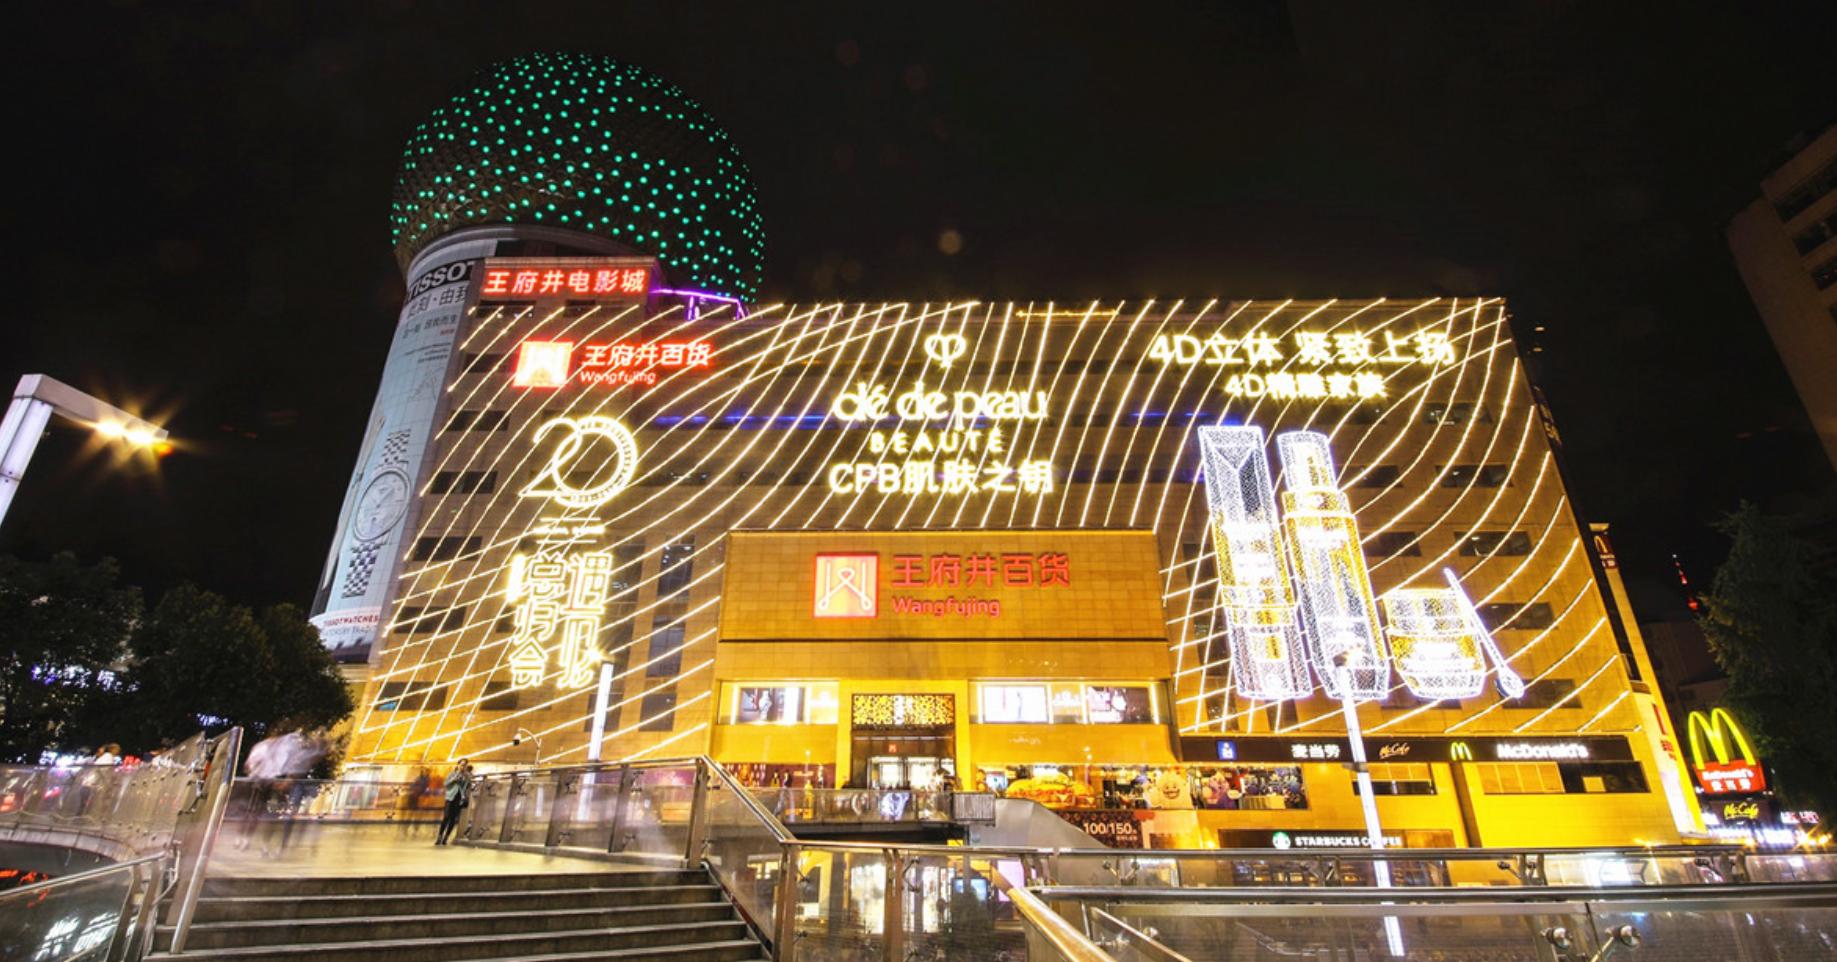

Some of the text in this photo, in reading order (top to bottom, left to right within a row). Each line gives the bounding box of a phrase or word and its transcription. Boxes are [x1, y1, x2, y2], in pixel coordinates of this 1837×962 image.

[484, 269, 647, 294] 王府井电影城
[581, 342, 712, 369] 王府井百货
[1150, 332, 1283, 366] 4D立体
[580, 370, 656, 386] Wangfujing
[895, 381, 948, 421] de
[953, 390, 1049, 432] peau
[869, 426, 1003, 453] BEAUTÉ
[828, 459, 1054, 494] CPB肌肤之钥
[891, 553, 1071, 588] 王府井百货
[891, 596, 1001, 618] Wangfujing
[1291, 743, 1341, 759] 麦当劳
[1496, 742, 1591, 760] McDonald's
[1295, 835, 1360, 847] STARBUCKS
